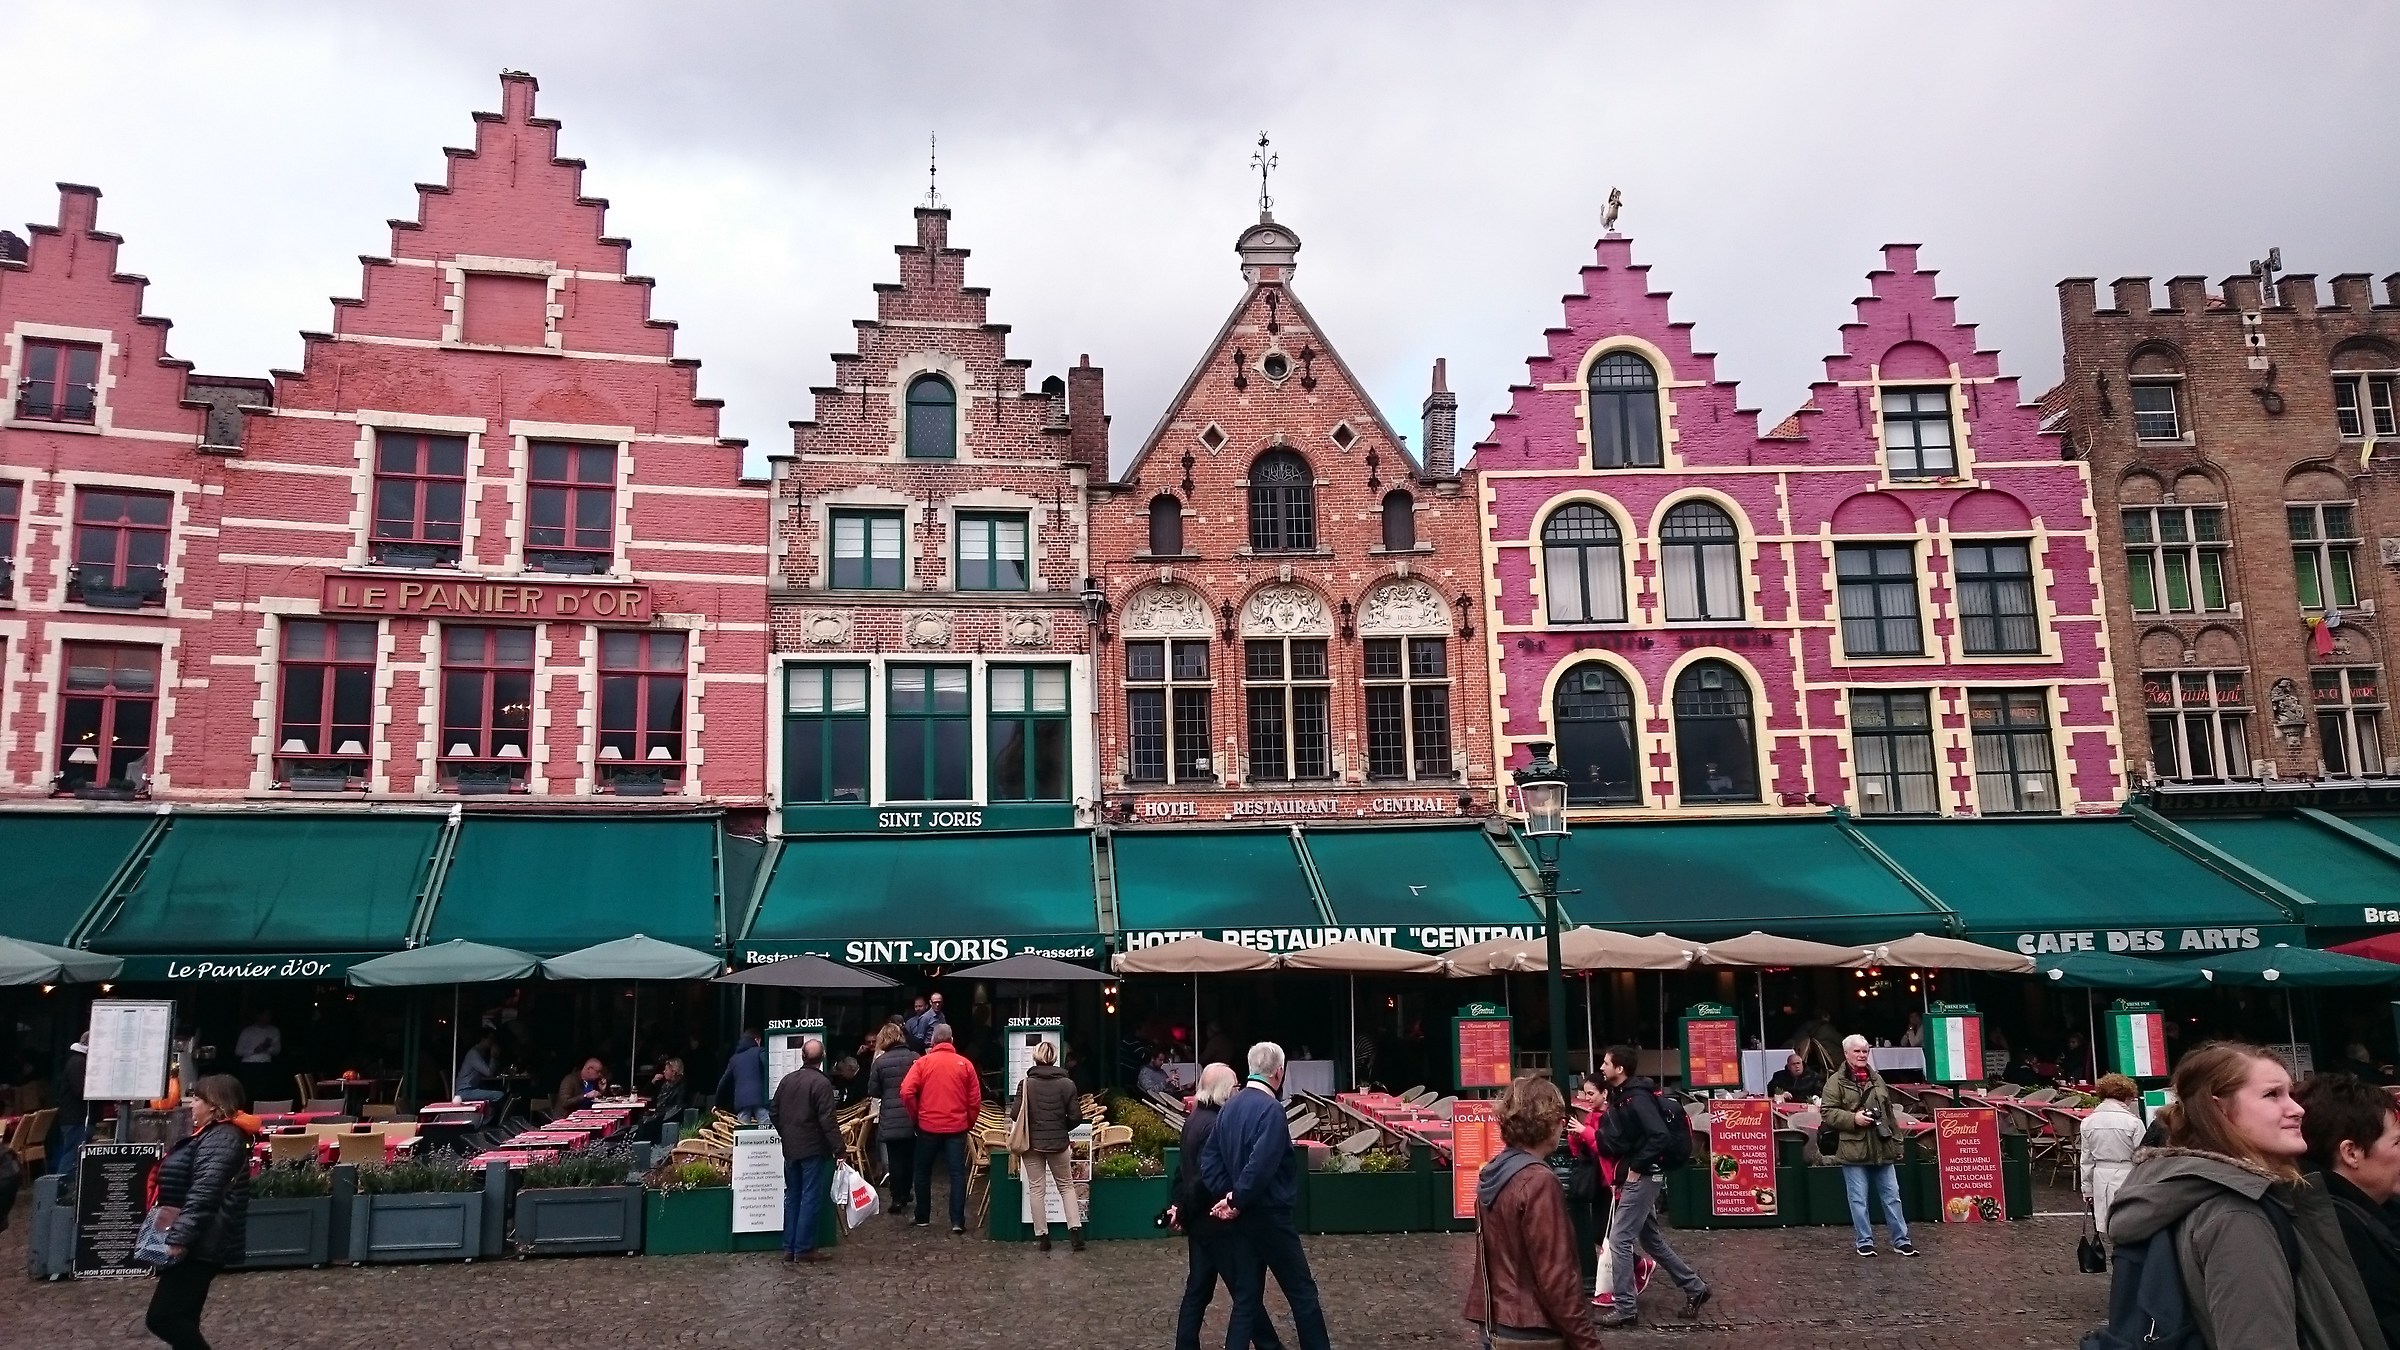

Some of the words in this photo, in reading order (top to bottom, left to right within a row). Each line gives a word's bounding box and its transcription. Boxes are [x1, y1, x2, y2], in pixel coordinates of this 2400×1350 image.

[336, 585, 388, 608] LE
[398, 582, 545, 613] PANIER
[555, 588, 643, 617] D'OR
[1144, 801, 1198, 817] HOTEL
[1233, 799, 1339, 815] RESTAURANT
[1372, 797, 1446, 812] CENTRAL
[879, 812, 922, 828] SINT
[928, 811, 982, 827] JORIS
[2364, 907, 2400, 923] Bra
[2016, 931, 2095, 954] CAFE
[2106, 931, 2165, 952] DES
[2179, 928, 2260, 950] ARTS
[846, 938, 1009, 963] SINT-JORIS
[167, 961, 196, 978] Le
[198, 961, 277, 979] Panier
[280, 959, 331, 976] d'Or
[768, 1019, 792, 1029] SINT
[795, 1018, 824, 1028] JORIS
[1008, 1017, 1031, 1026] SINT
[1033, 1016, 1061, 1026] JORIS
[1454, 1114, 1486, 1122] LOCAL
[1725, 1110, 1762, 1129] Central
[1719, 1132, 1740, 1140] LIGHT
[1741, 1132, 1767, 1140] LUNCH
[1940, 1119, 1979, 1138] Central
[87, 1146, 119, 1156] MENU
[120, 1146, 128, 1155] €
[131, 1146, 155, 1156] 17,50
[1949, 1156, 1991, 1164] MOSSELMENU
[1951, 1182, 1972, 1190] LOCAL
[1972, 1181, 1993, 1189] DISHES
[84, 1268, 100, 1276] NON
[99, 1268, 115, 1276] STOP
[115, 1267, 142, 1275] KITCHEN
